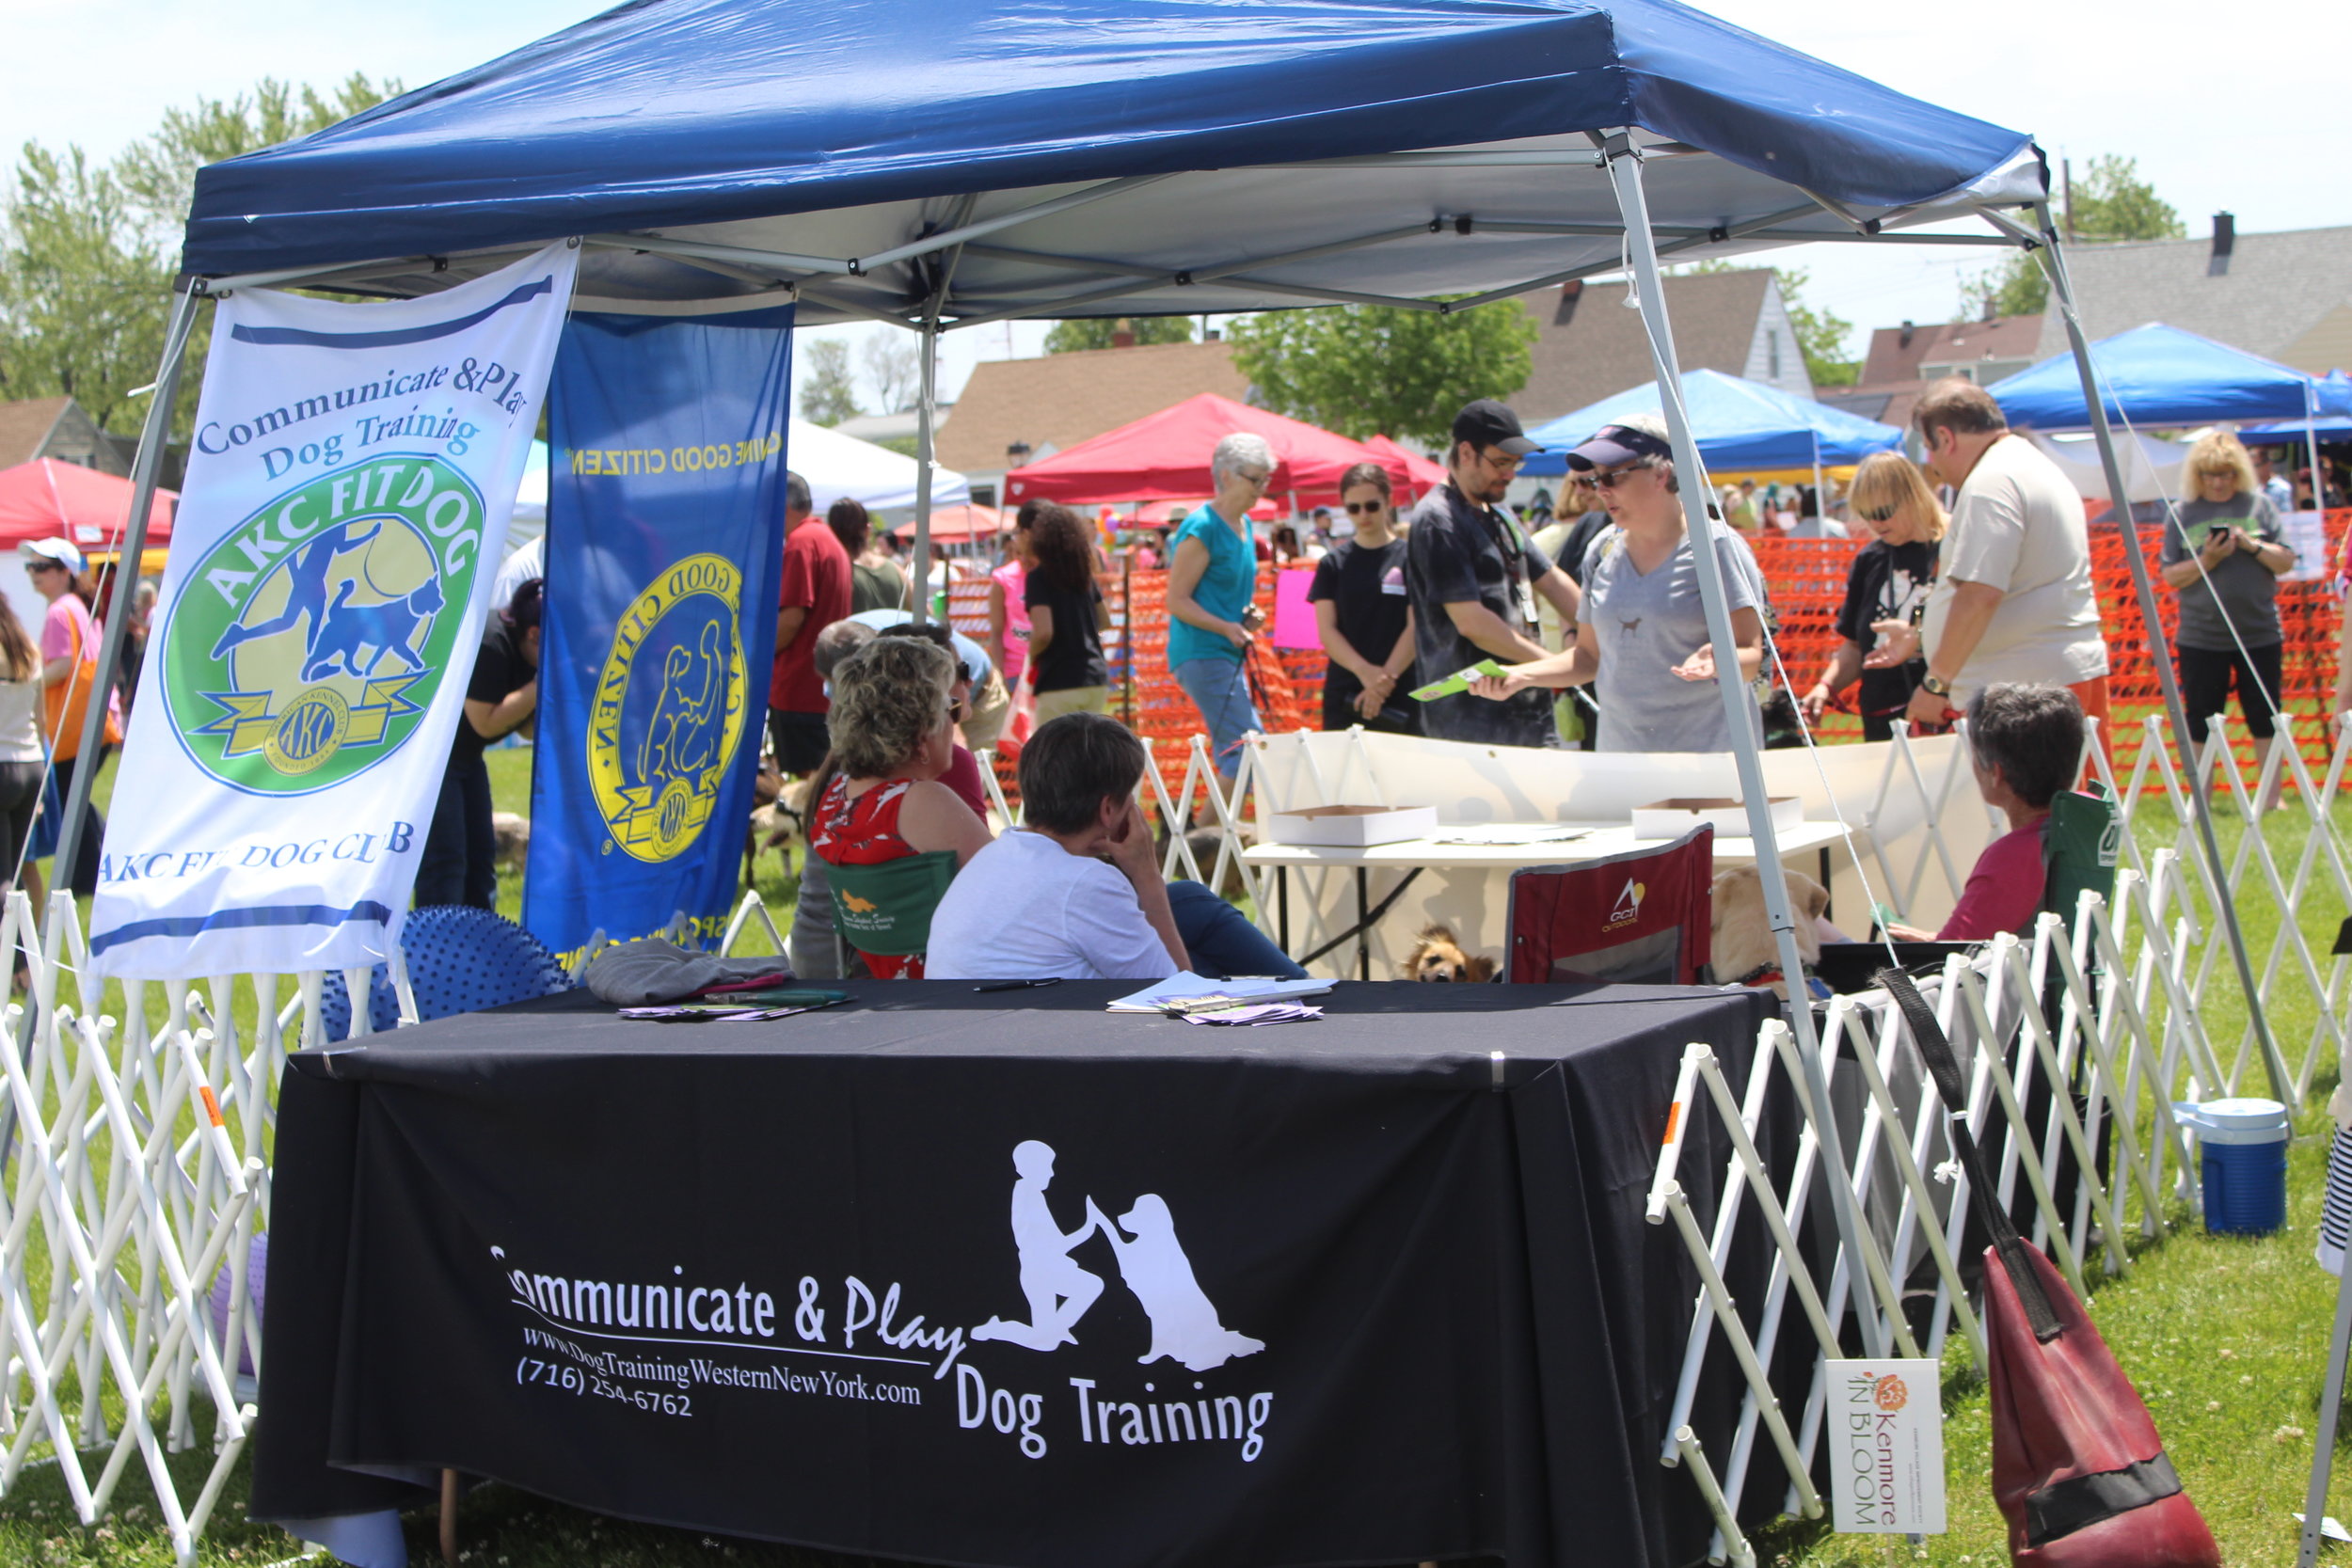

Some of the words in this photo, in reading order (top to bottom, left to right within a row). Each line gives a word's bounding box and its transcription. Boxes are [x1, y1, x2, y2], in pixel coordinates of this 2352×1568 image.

[196, 363, 450, 456] Communicate
[260, 433, 344, 483] Dog
[356, 404, 481, 457] Training
[204, 496, 319, 609] AKC
[330, 464, 405, 517] FIT
[397, 466, 479, 578] DOG
[279, 704, 333, 759] AKC
[98, 851, 173, 883] AKC
[173, 849, 230, 879] FI
[239, 838, 328, 868] DOG
[331, 820, 415, 863] CLB
[523, 1326, 923, 1406] www.DogTrainingWesternNewYork.com
[794, 1275, 827, 1343] &
[845, 1275, 967, 1381] Play
[516, 1355, 586, 1396] (716)
[592, 1378, 693, 1418] 254-6762
[956, 1362, 1048, 1459] Dog
[1069, 1376, 1274, 1463] Training
[1847, 1376, 1870, 1403] IN
[1849, 1412, 1877, 1526] BLOOM
[1875, 1413, 1898, 1526] Kenmore
